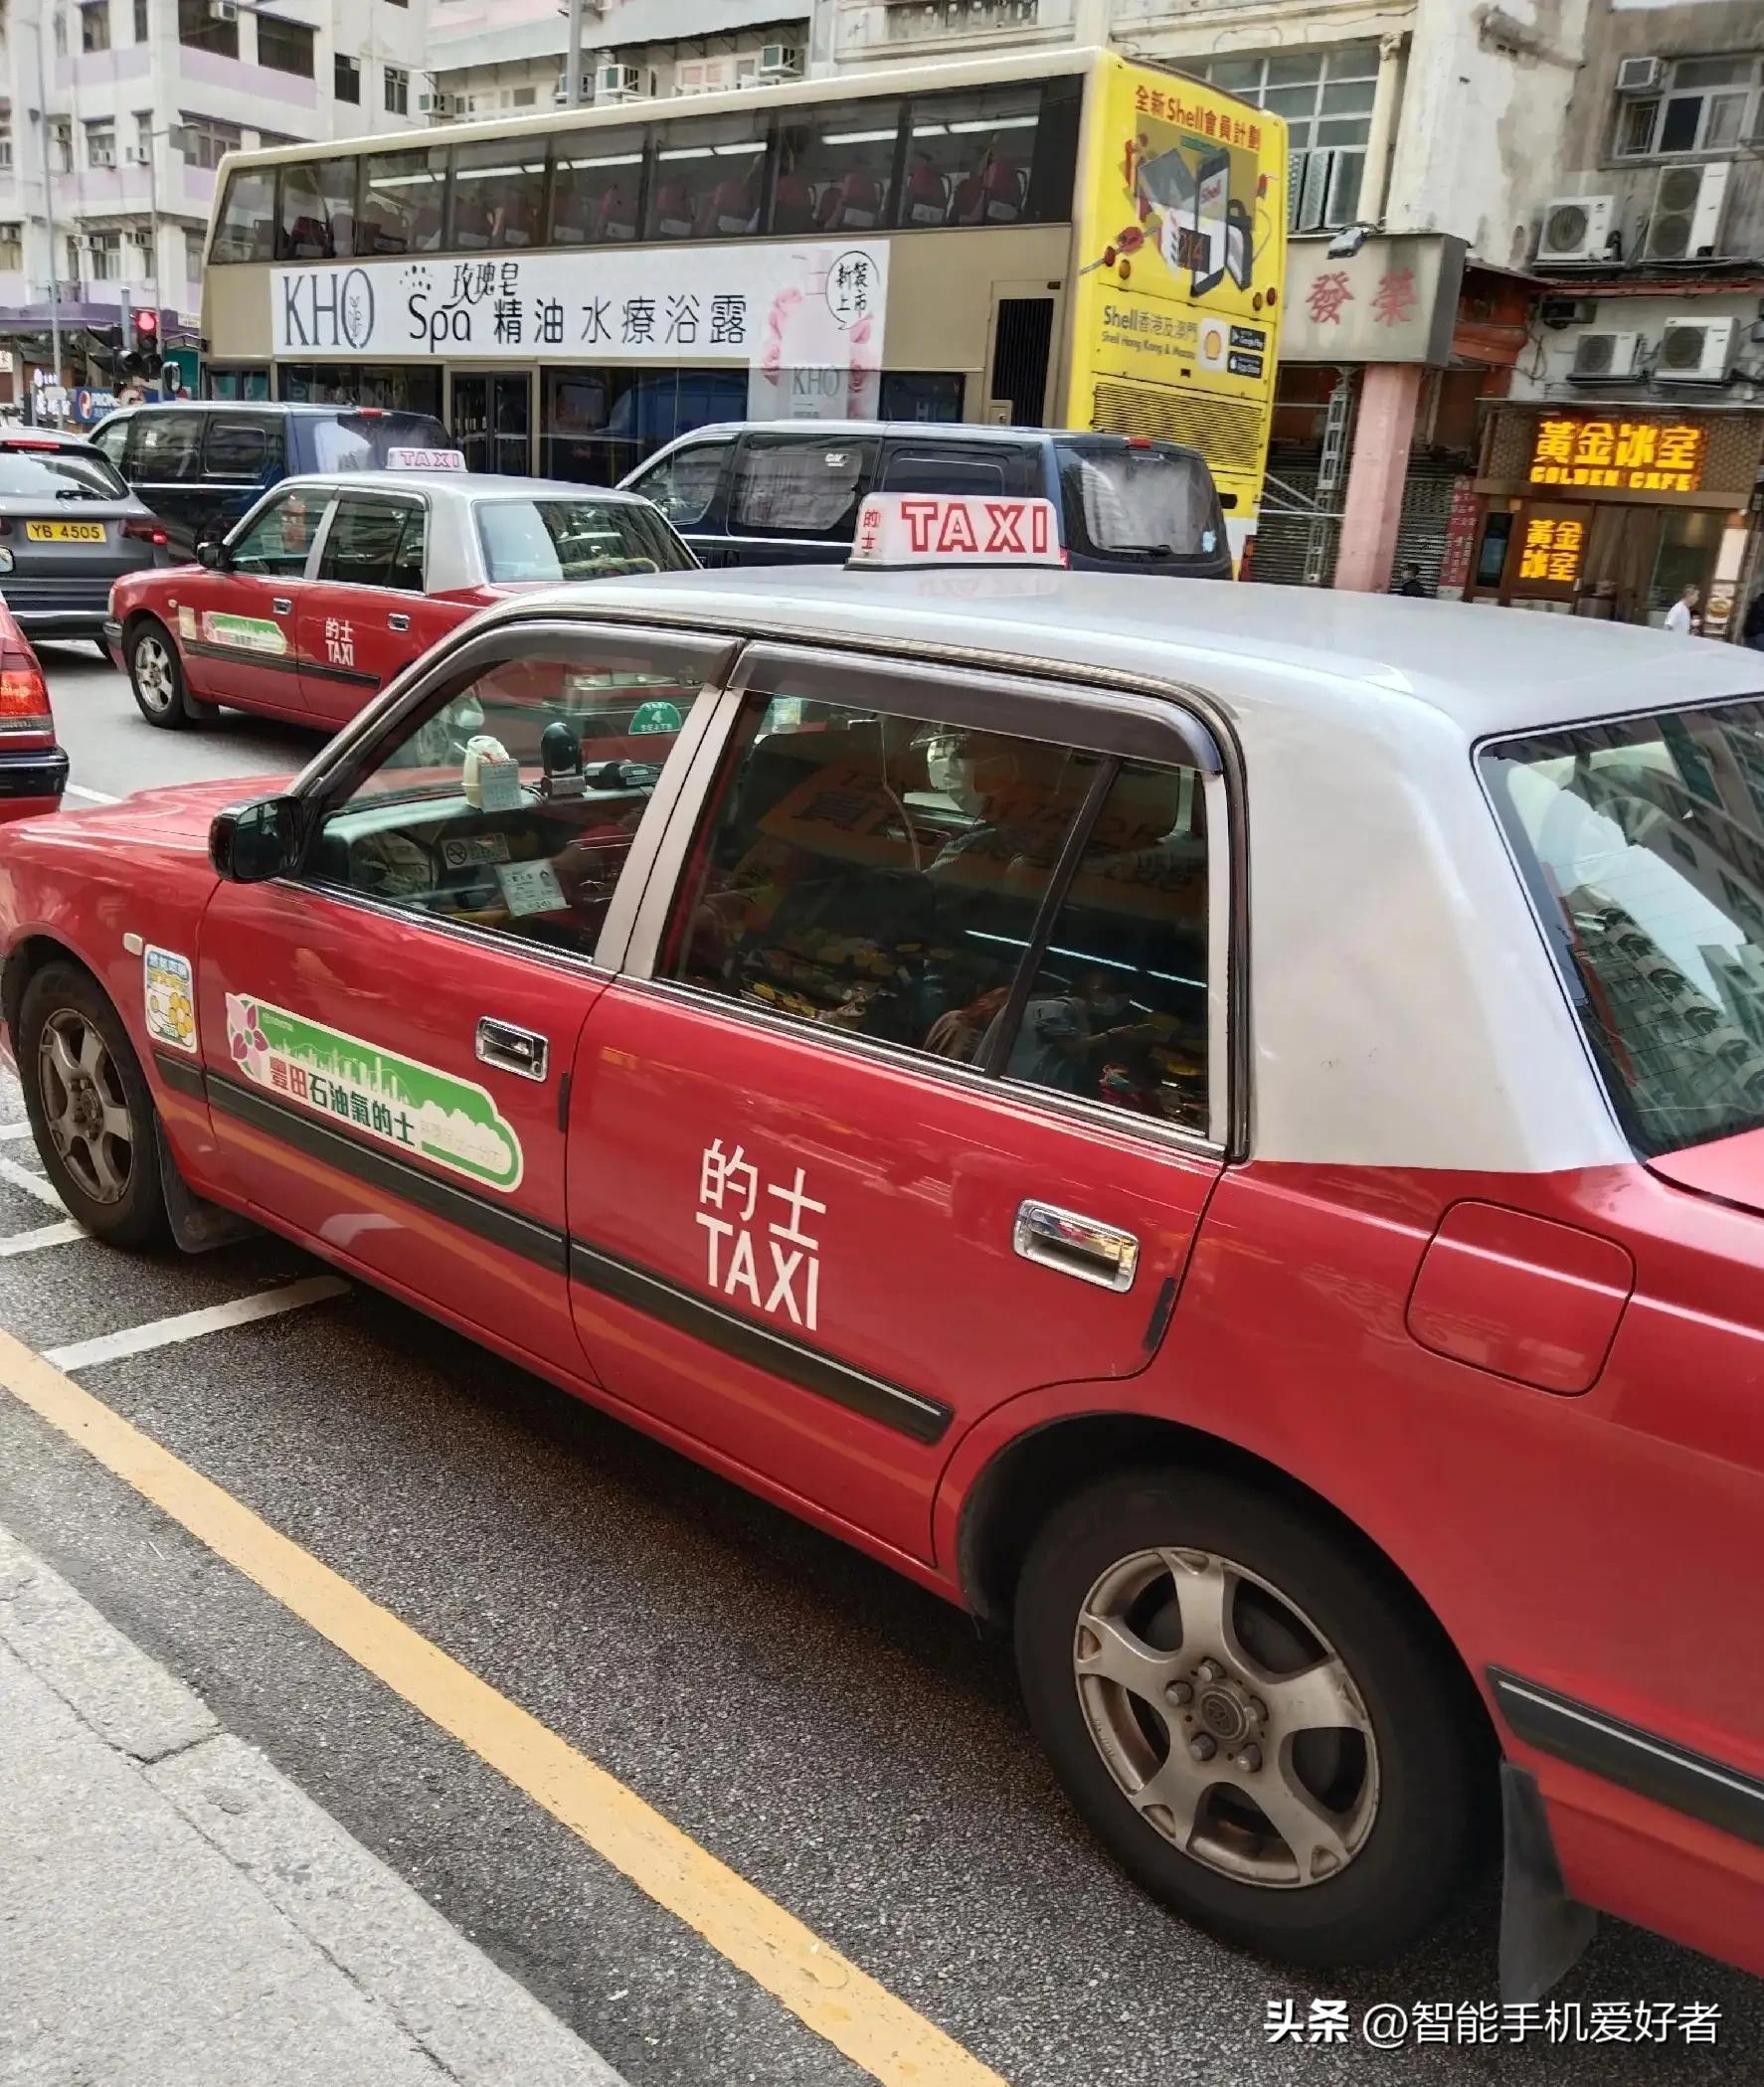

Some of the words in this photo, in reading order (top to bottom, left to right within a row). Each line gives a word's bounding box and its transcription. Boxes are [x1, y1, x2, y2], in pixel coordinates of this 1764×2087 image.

[283, 266, 375, 350] KHO
[441, 261, 519, 310] 玫瑰皂
[409, 293, 472, 353] Spa
[493, 294, 747, 346] 精油水療浴露
[401, 451, 460, 468] TAXI
[31, 524, 54, 538] YB
[60, 525, 100, 539] 4505
[861, 508, 882, 552] 的士
[901, 501, 1048, 554] TAXI
[325, 617, 354, 643] 的士
[325, 639, 354, 666] TAXI
[269, 1056, 416, 1147] 豐田石油氣的士
[699, 1137, 826, 1251] 的士
[696, 1211, 819, 1331] TAXI
